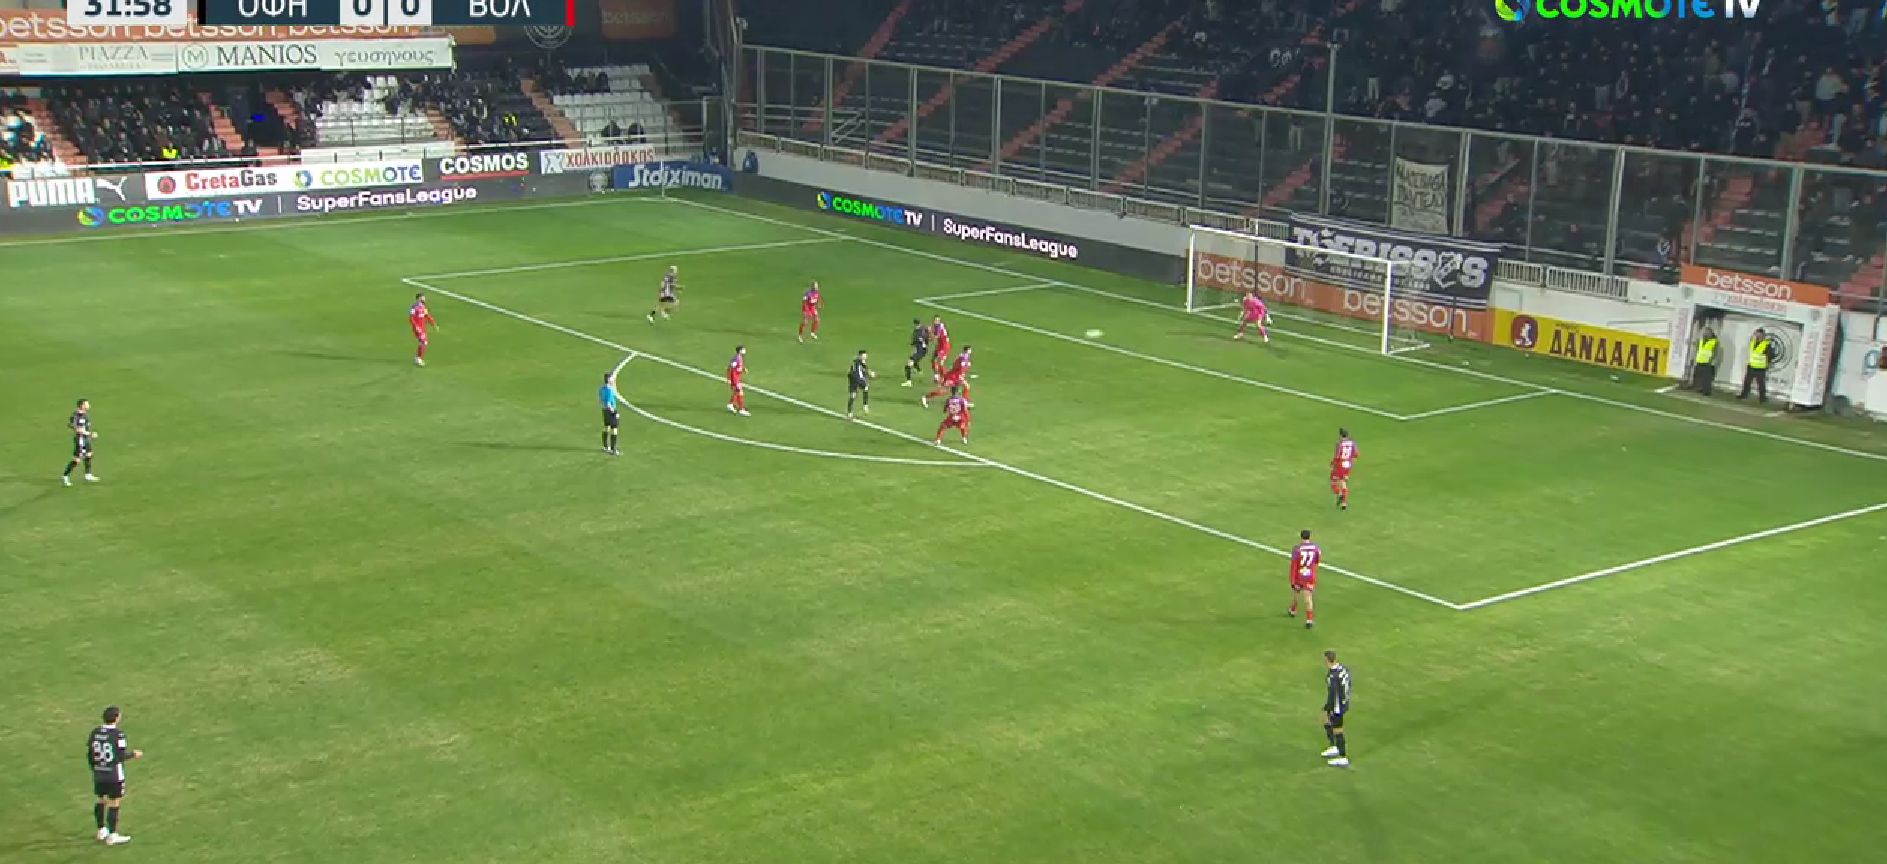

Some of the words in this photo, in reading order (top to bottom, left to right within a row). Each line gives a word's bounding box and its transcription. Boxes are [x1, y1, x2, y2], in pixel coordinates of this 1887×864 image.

[217, 44, 318, 66] MANIOS
[320, 164, 422, 186] COSMOTE
[440, 153, 529, 175] COSMOS
[628, 164, 724, 189] Stoiximan
[8, 178, 96, 207] PUMA
[185, 169, 279, 191] CretaGas
[108, 201, 232, 223] COSMOTE
[233, 199, 263, 215] TV
[297, 185, 477, 212] SuperFansLeague
[831, 196, 904, 224] COSMOTE
[904, 209, 923, 228] TV
[943, 218, 1079, 259] SuperFansLeague
[1197, 256, 1306, 299] betsson
[1705, 268, 1792, 300] betsson
[1344, 288, 1467, 332] besson
[1549, 328, 1660, 373] ΔΑΝΔΑΛΗ
[1300, 551, 1314, 567] 77
